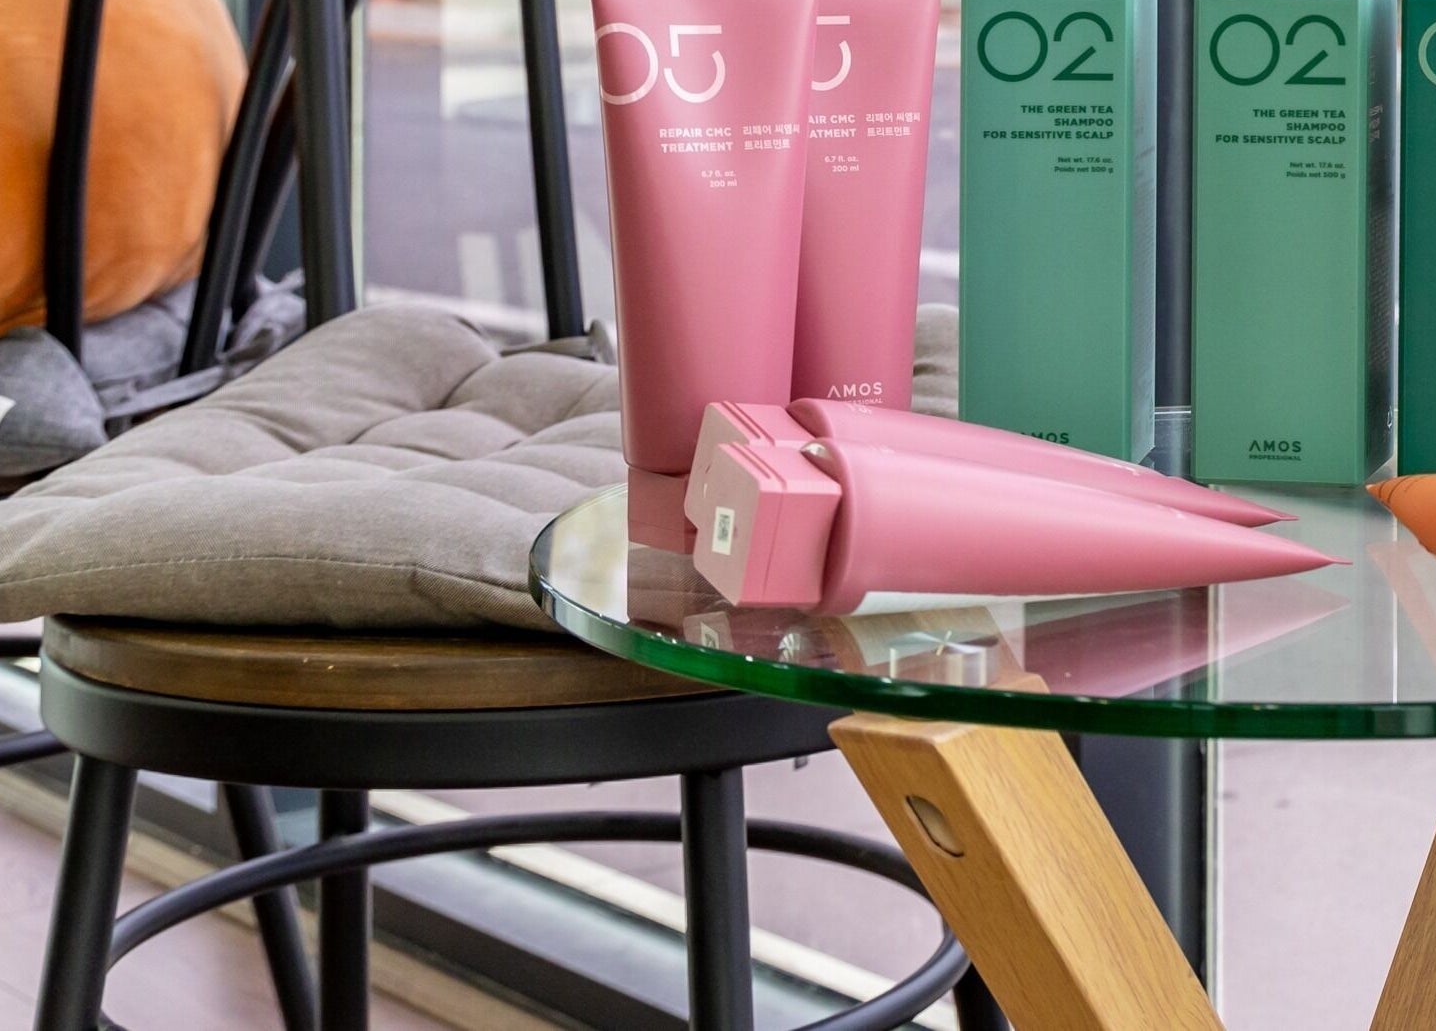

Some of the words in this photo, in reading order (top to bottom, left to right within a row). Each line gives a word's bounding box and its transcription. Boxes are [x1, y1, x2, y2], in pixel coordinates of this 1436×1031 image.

[977, 11, 1114, 83] 02
[1209, 14, 1347, 86] 02
[811, 15, 851, 91] 5
[1020, 105, 1043, 114] THE
[1047, 105, 1087, 114] GREEN
[1090, 105, 1114, 114] TEA
[1253, 109, 1276, 118] THE
[1279, 109, 1319, 118] GREEN
[1322, 110, 1346, 119] TEA
[808, 115, 827, 124] AIR
[830, 114, 856, 124] CMC
[1054, 118, 1114, 127] SHAMPOO
[1286, 122, 1346, 132] SHAMPOO
[659, 128, 702, 138] REPAIR
[705, 127, 732, 137] CMC
[809, 128, 856, 138] ATMENT
[983, 130, 1007, 139] FOR
[1010, 130, 1072, 139] SENSITIVE
[1075, 131, 1114, 140] SCALP
[1215, 134, 1239, 143] FOR
[1243, 135, 1304, 144] SENSITIVE
[1307, 136, 1346, 145] SCALP
[661, 141, 733, 153] TREATMENT
[824, 155, 836, 163] 6.7
[727, 179, 737, 187] ml
[827, 381, 883, 398] AMOS
[1249, 440, 1302, 453] AMOS
